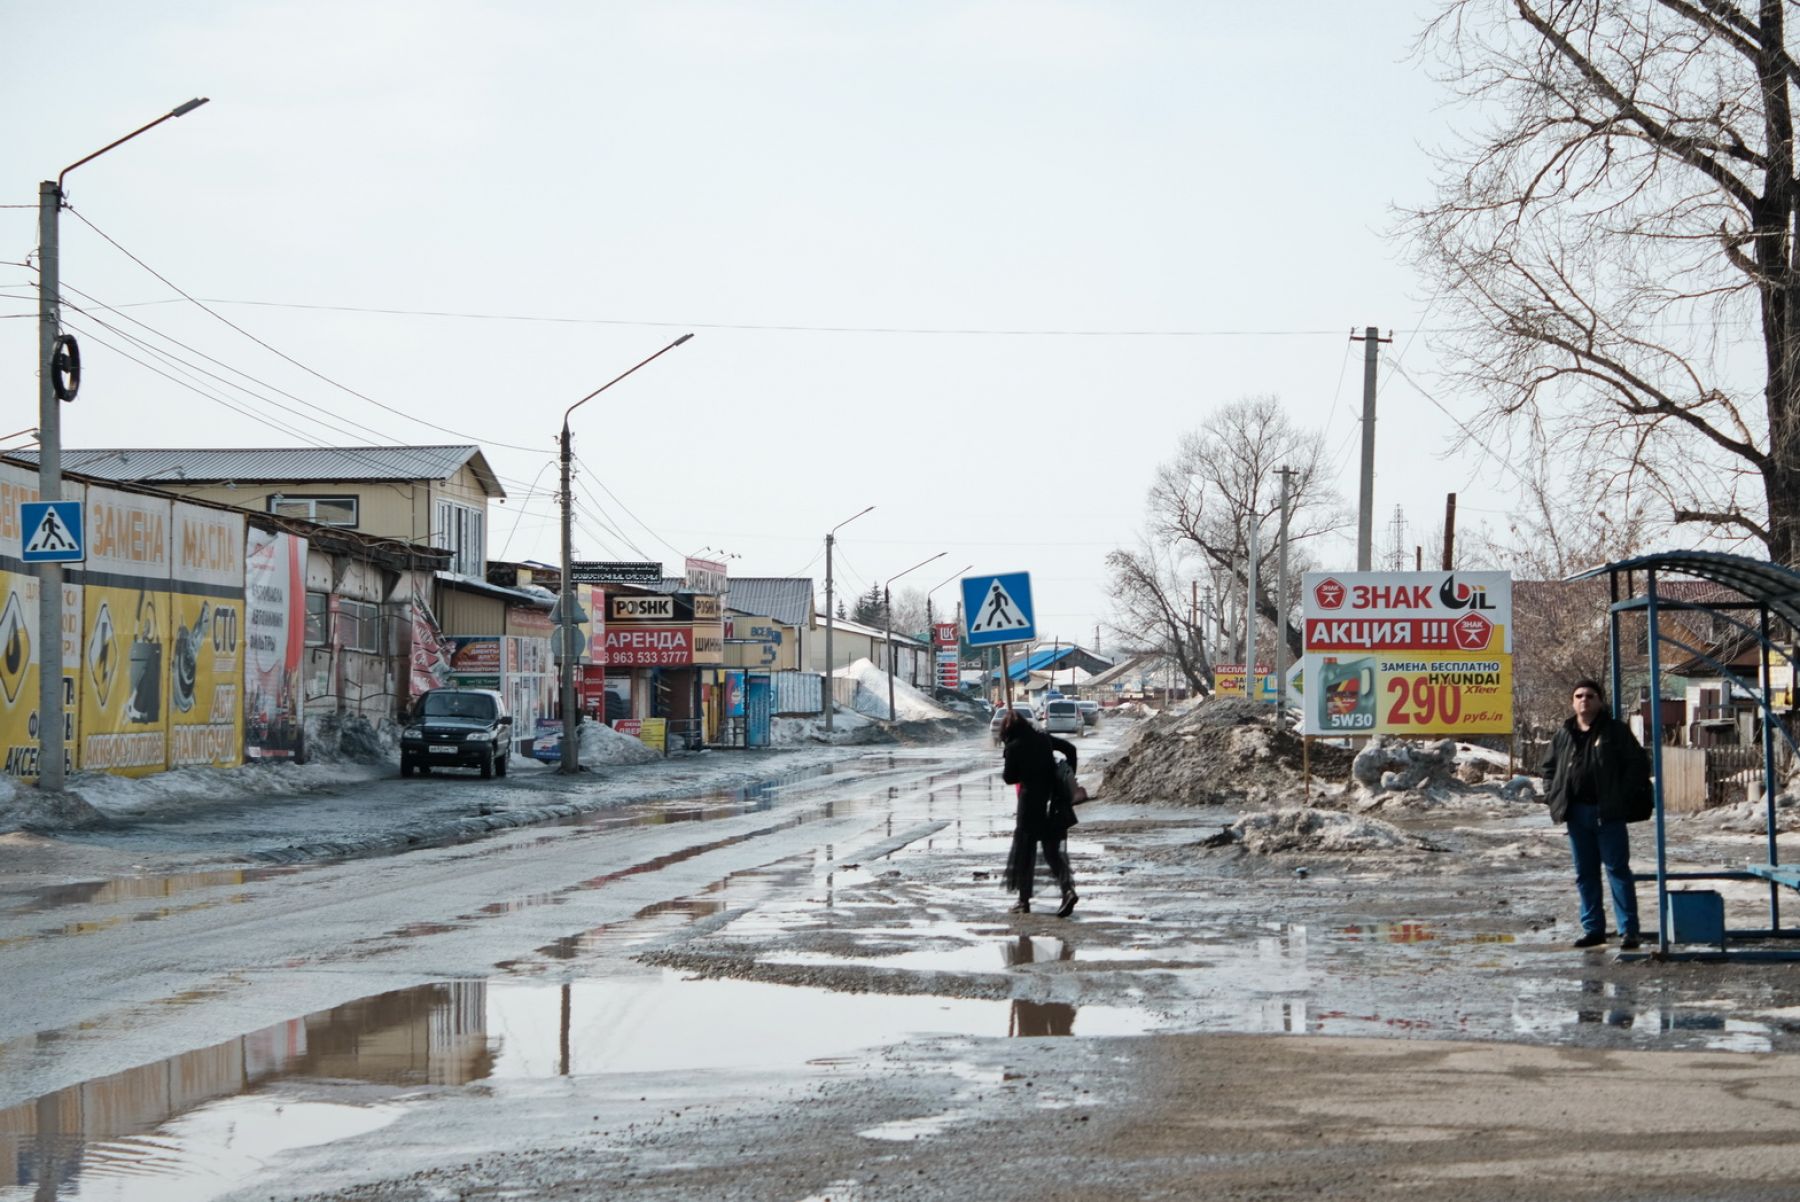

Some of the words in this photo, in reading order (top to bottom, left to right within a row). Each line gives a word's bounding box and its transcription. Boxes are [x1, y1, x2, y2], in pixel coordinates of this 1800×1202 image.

[94, 504, 164, 563] ЗАМЕНА
[183, 519, 236, 572] МАСЛА
[1352, 586, 1433, 609] ЗНАК
[213, 607, 236, 652] СТО
[1462, 621, 1483, 629] ЗНАК
[606, 632, 687, 649] АРЕНДА
[1311, 622, 1411, 648] АКЦИЯ
[1421, 622, 1448, 643] !!!
[613, 652, 634, 664] 963
[637, 652, 658, 664] 533
[661, 651, 688, 663] 3777
[1381, 662, 1427, 671] ЗАМЕНА
[1431, 662, 1499, 671] БЕСПЛАТНО
[1428, 673, 1500, 685] HYUNDAI
[1387, 676, 1462, 725] 290
[1331, 713, 1373, 727] 5W30
